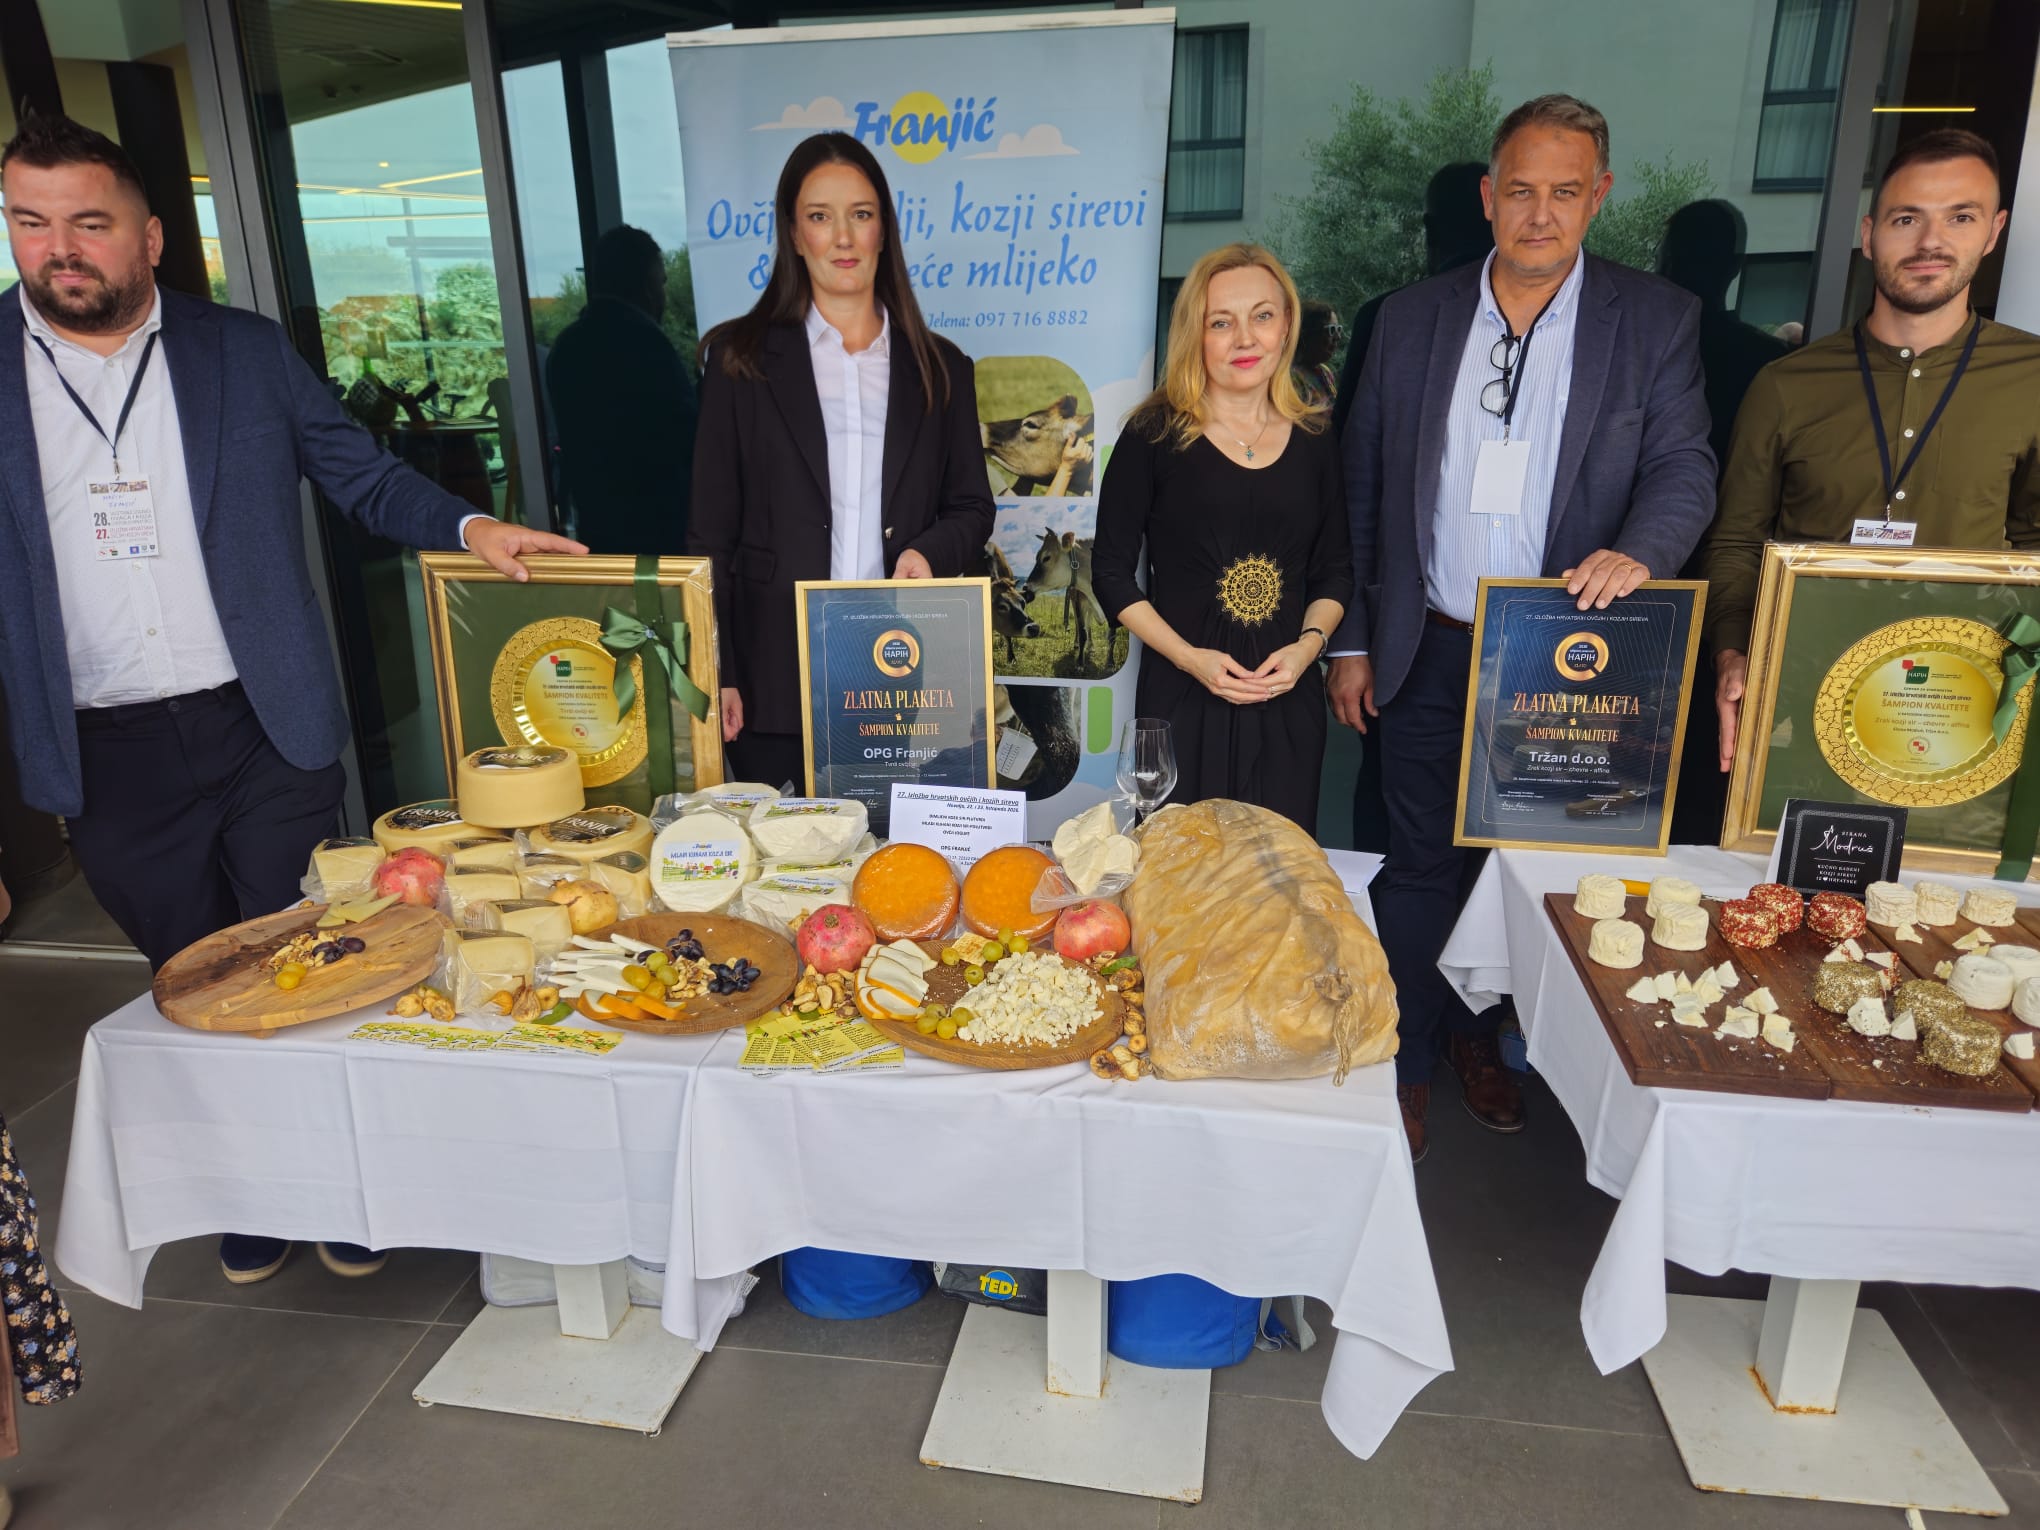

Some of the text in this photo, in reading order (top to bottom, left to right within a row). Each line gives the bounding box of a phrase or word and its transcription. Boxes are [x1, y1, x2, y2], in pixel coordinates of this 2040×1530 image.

[854, 97, 997, 152] Franjić
[707, 199, 775, 245] Ovčj
[951, 181, 1035, 241] kozji
[1049, 190, 1148, 232] sirevi
[748, 253, 772, 290] &
[967, 234, 1098, 295] mlijeko
[928, 310, 1088, 328] Jelena: 097 716 8882
[884, 650, 908, 658] HAPIH
[1568, 653, 1596, 662] HAPIH
[843, 689, 954, 709] ZLATNA PLAKETA
[1513, 692, 1639, 715] ZLATNA PLAKETA
[1881, 698, 1969, 712] ŠAMPION KVALITETE
[859, 722, 940, 737] ŠAMPION KVALITETE
[1526, 725, 1619, 742] ŠAMPION KVALITETE
[864, 747, 938, 760] OPG Franjić
[1529, 751, 1610, 765] Tržan d.o.o.
[980, 1275, 1019, 1298] TEDi
